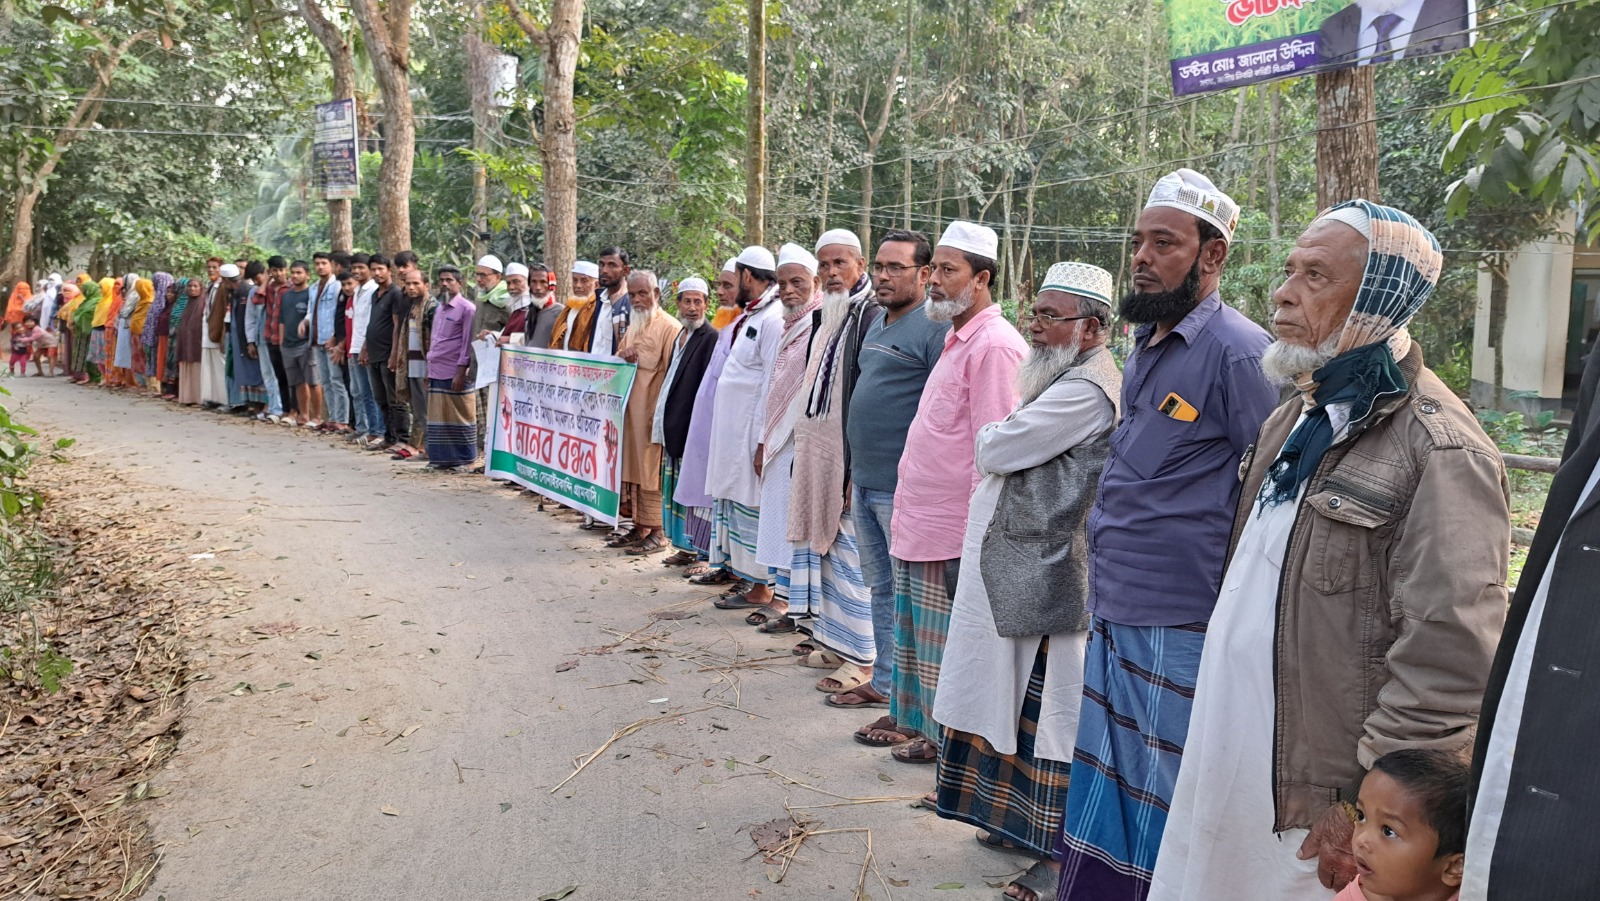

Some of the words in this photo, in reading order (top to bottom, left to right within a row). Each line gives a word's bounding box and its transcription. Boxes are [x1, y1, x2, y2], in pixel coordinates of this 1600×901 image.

[1179, 61, 1209, 79] ডক্টর
[1212, 58, 1235, 72] মোঃ
[1237, 49, 1277, 67] জালাল
[1279, 40, 1315, 59] উদ্দিন
[554, 410, 575, 430] মামলার
[576, 409, 601, 437] প্রতিবাদে
[515, 421, 554, 464] মানব
[558, 432, 597, 480] বন্ধন
